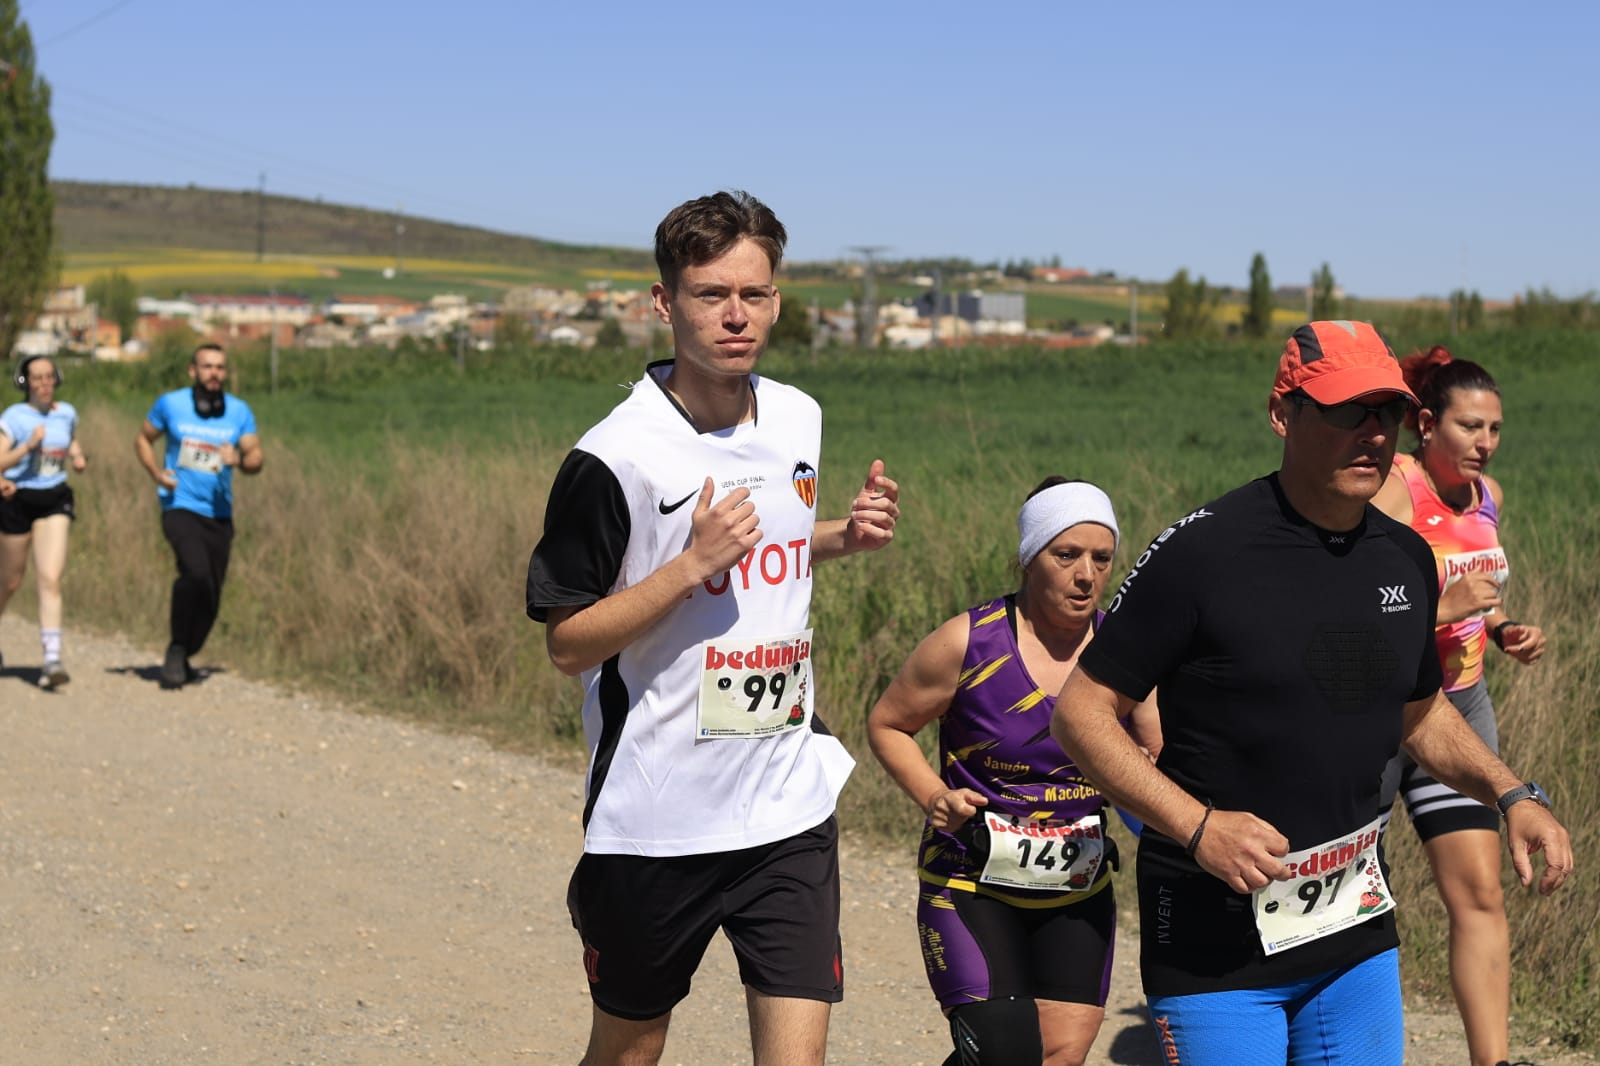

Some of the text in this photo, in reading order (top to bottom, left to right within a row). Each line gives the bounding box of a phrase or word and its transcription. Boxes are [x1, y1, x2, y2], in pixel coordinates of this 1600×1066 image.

[721, 475, 766, 489] UEFA CUP FINAL
[706, 639, 810, 670] bedunia
[744, 672, 786, 712] 99
[984, 756, 1031, 772] Jamón
[1017, 838, 1080, 871] 149
[1285, 829, 1378, 879] edunia
[1297, 868, 1347, 915] 97
[1157, 885, 1173, 944] INVENT
